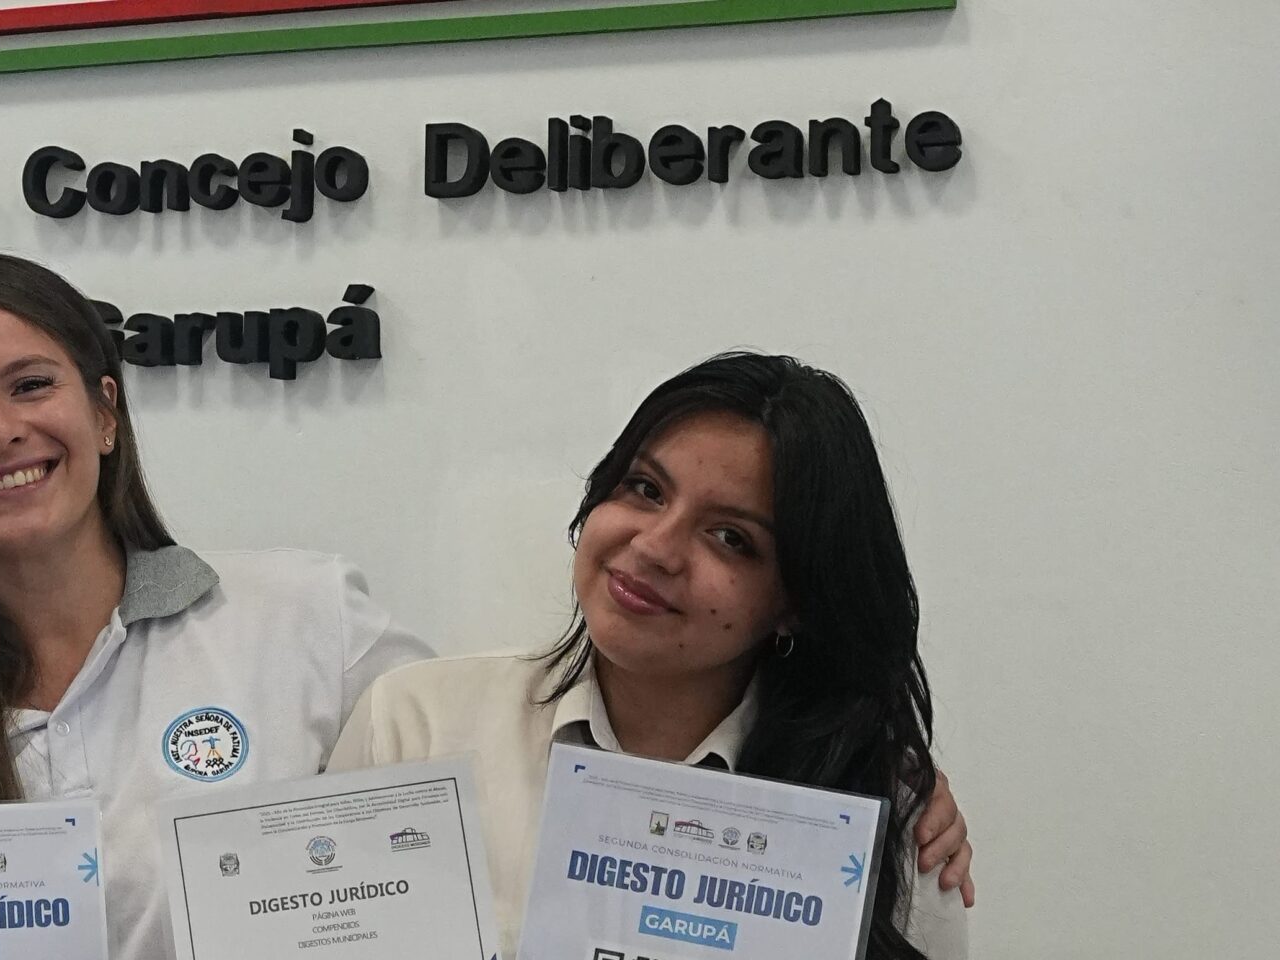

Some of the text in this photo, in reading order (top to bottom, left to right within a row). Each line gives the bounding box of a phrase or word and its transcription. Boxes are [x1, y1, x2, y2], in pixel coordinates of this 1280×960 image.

[22, 128, 369, 222] Concejo
[424, 97, 963, 199] Deliberante
[171, 719, 194, 746] NUESTRA
[195, 712, 223, 725] SEÑORA
[223, 721, 232, 732] DE
[598, 834, 649, 851] SEGUNDA
[741, 861, 804, 880] NORMATIVA
[249, 879, 409, 915] DIGESTO JURÍDICO
[567, 850, 823, 926] DIGESTO JURÍDICO
[312, 921, 360, 934] COMPENDIOS
[340, 908, 356, 917] WEB
[645, 914, 731, 944] GARUPÁ
[298, 931, 378, 949] DIGESTOS MUNICIPALES
